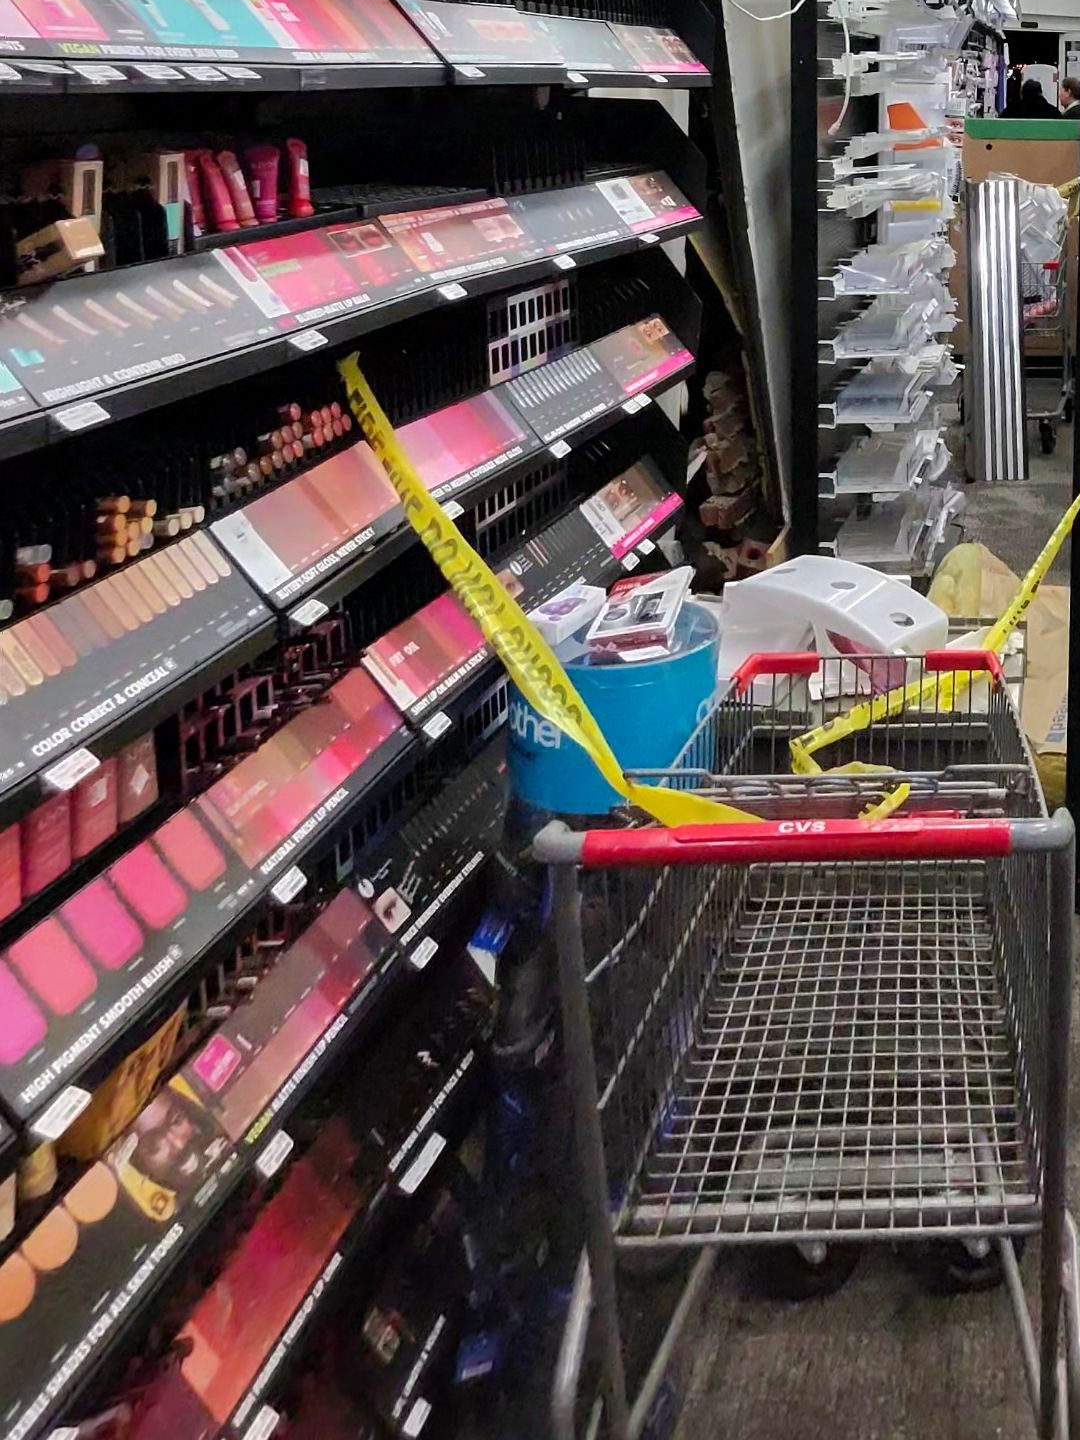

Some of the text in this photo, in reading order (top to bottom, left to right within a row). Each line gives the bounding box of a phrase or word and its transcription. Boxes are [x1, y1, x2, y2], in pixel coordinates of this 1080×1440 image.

[42, 376, 103, 403] HIGHLIGHT
[31, 666, 170, 757] COLOR CORRECT & CONCEAL
[260, 787, 349, 875] NATURAL FINISH LIP PENCIL
[778, 820, 826, 834] CVS
[19, 955, 175, 1104] HIGH PIGMENT SMOOTH BLUSH
[244, 1107, 275, 1144] VEGAN
[46, 1339, 92, 1398] SHADES
[87, 1310, 114, 1344] FOR
[109, 1290, 131, 1316] ALL
[126, 1259, 155, 1296] SKIN
[150, 1222, 184, 1264] TONES
